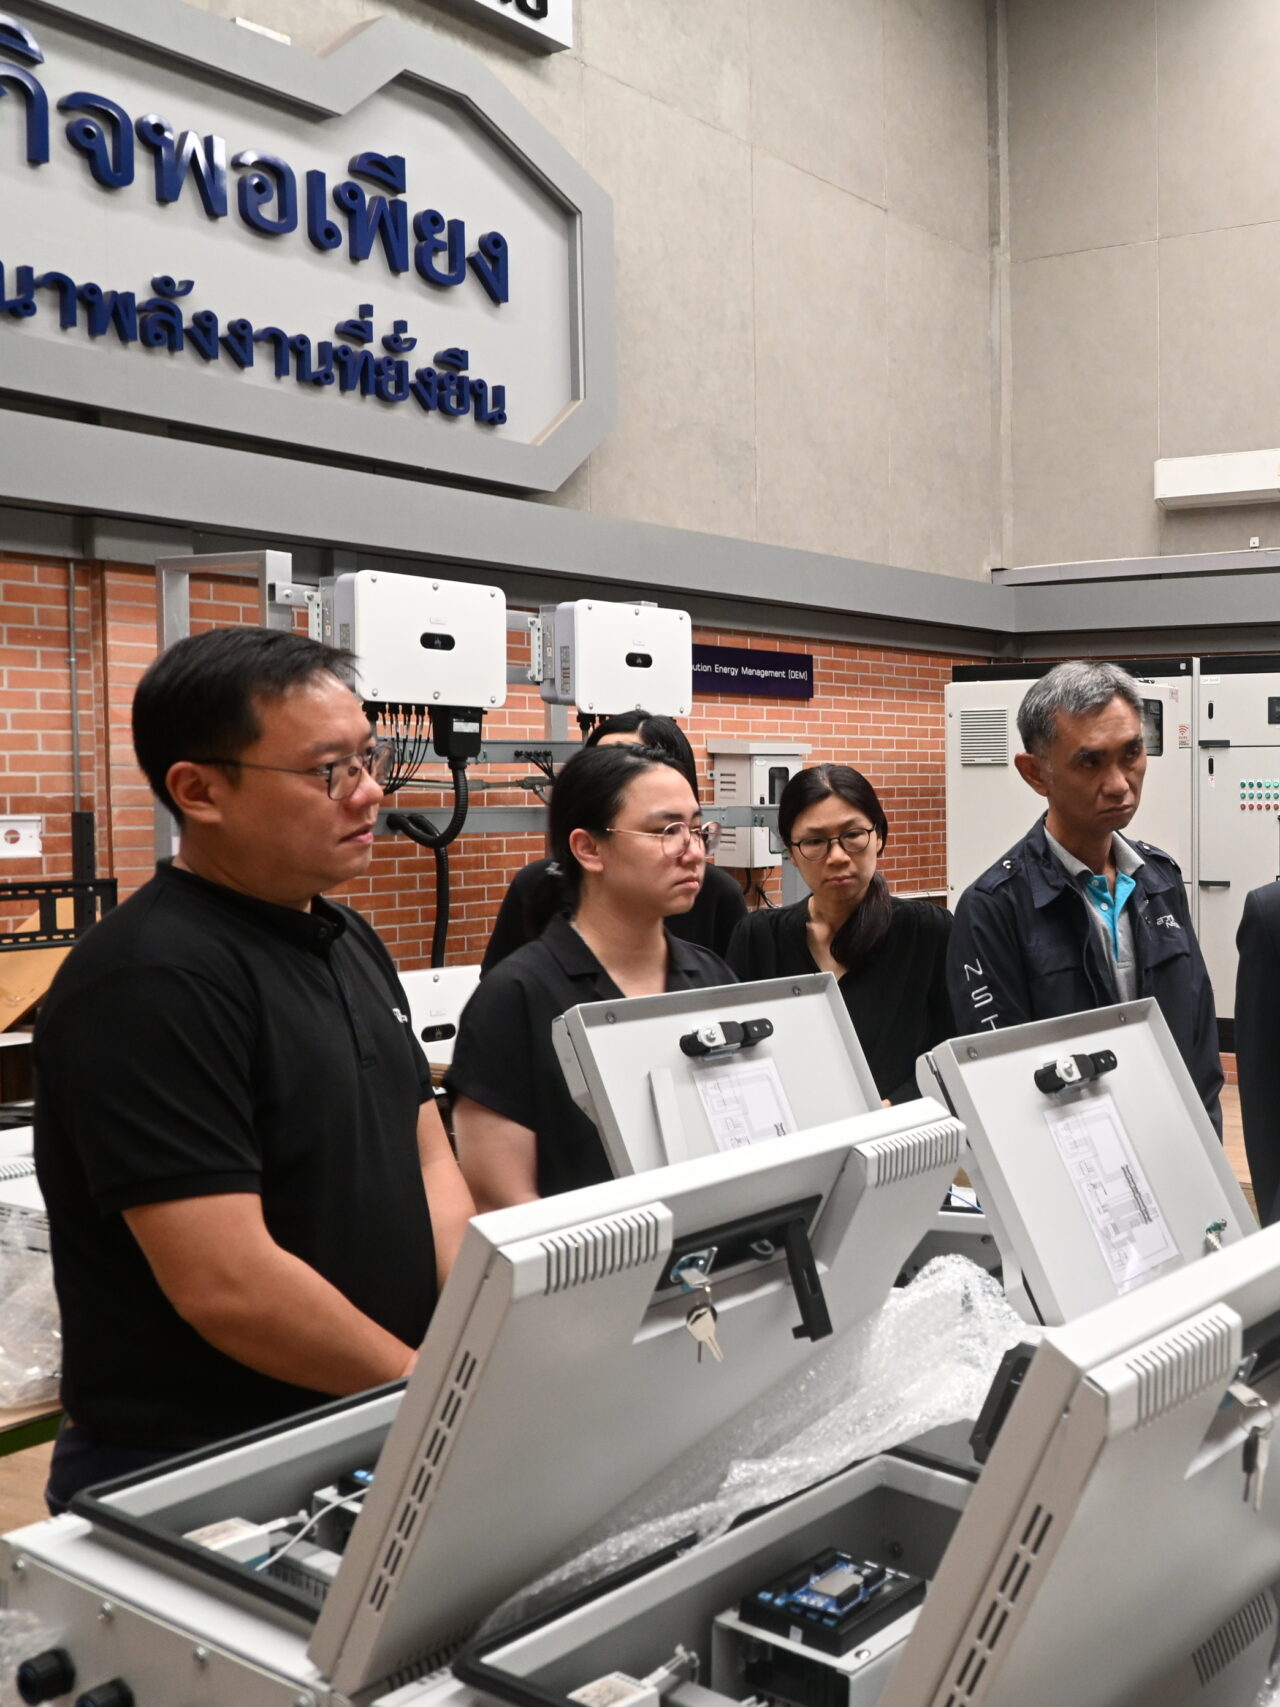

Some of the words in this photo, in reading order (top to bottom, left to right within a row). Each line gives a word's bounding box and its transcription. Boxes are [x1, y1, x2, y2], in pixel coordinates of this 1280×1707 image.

[714, 664, 738, 676] Energy
[741, 666, 786, 679] Management
[788, 669, 808, 681] (DEM)
